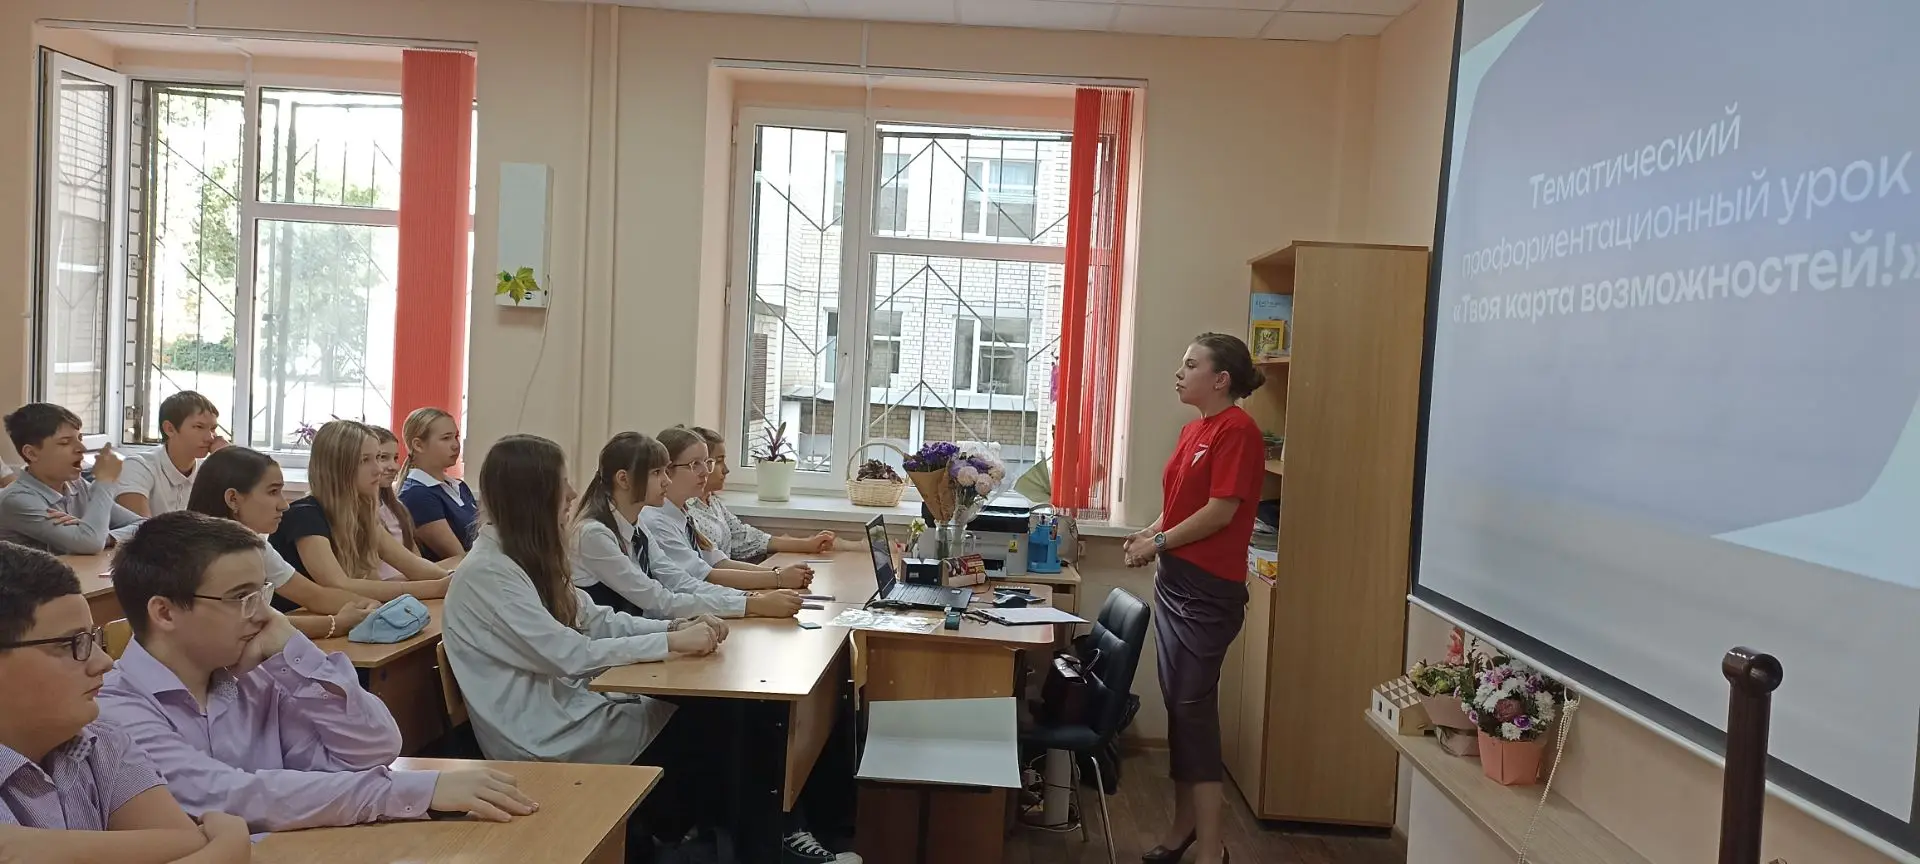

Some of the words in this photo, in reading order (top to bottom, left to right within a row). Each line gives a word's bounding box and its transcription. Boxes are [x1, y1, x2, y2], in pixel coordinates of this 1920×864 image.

[1529, 100, 1741, 208] Тематический
[1462, 166, 1770, 280] профориентационный
[1777, 150, 1913, 225] урок
[1453, 293, 1501, 323] «Твоя
[1505, 284, 1575, 324] карта
